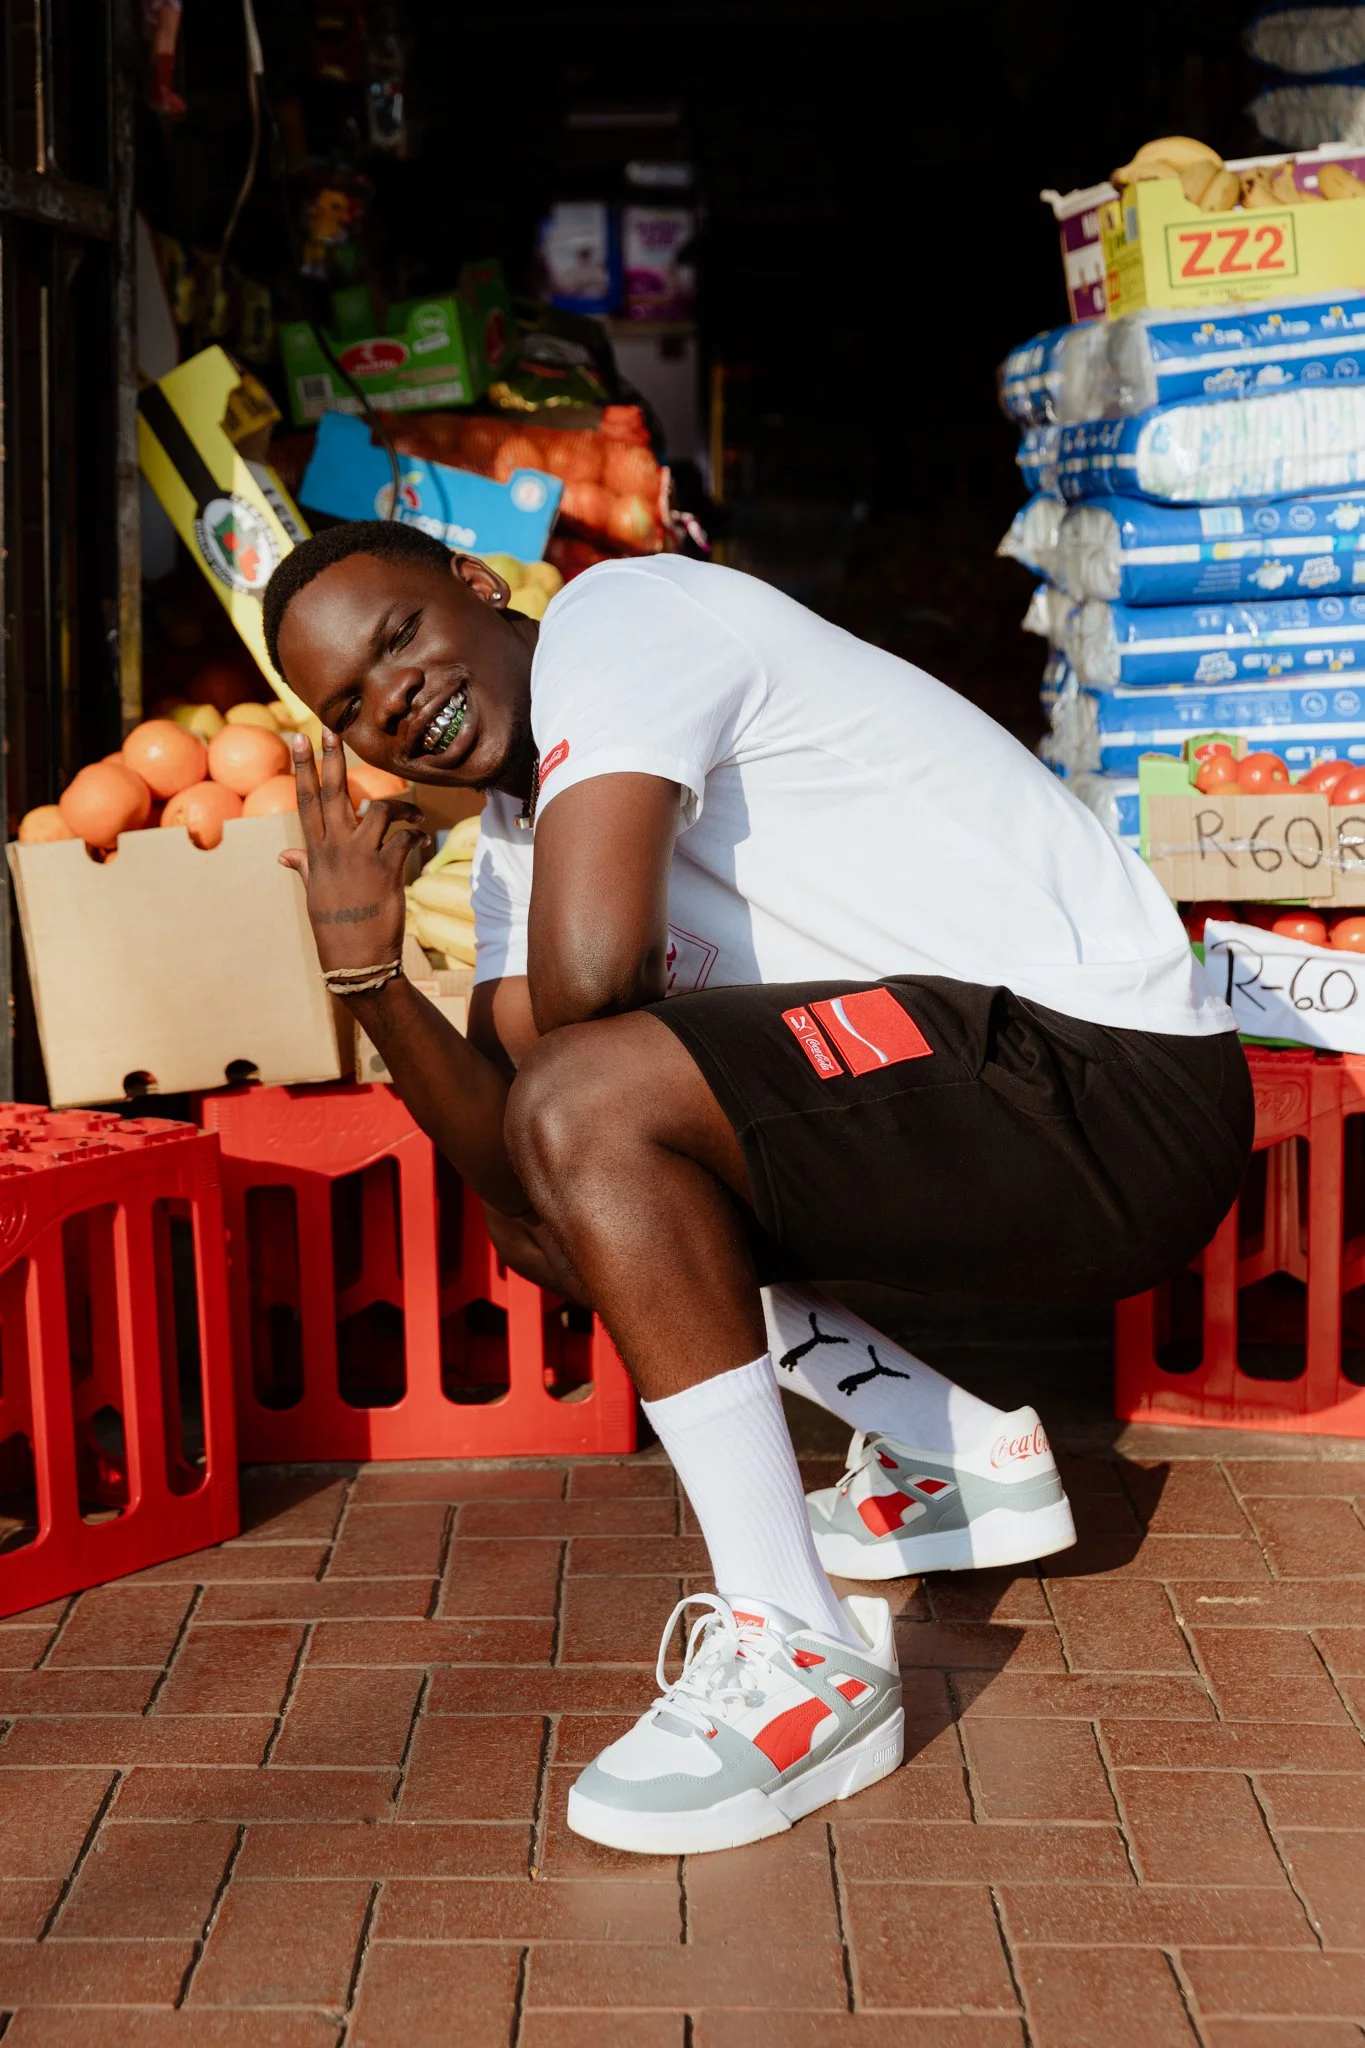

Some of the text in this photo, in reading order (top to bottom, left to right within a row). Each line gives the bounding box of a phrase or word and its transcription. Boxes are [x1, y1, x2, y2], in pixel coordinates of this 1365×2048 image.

[1179, 226, 1286, 279] ZZ2
[1194, 809, 1323, 873] R-60
[1211, 939, 1358, 1013] R-60
[805, 1037, 835, 1072] Coca-Cola
[873, 1743, 897, 1767] PUMA
